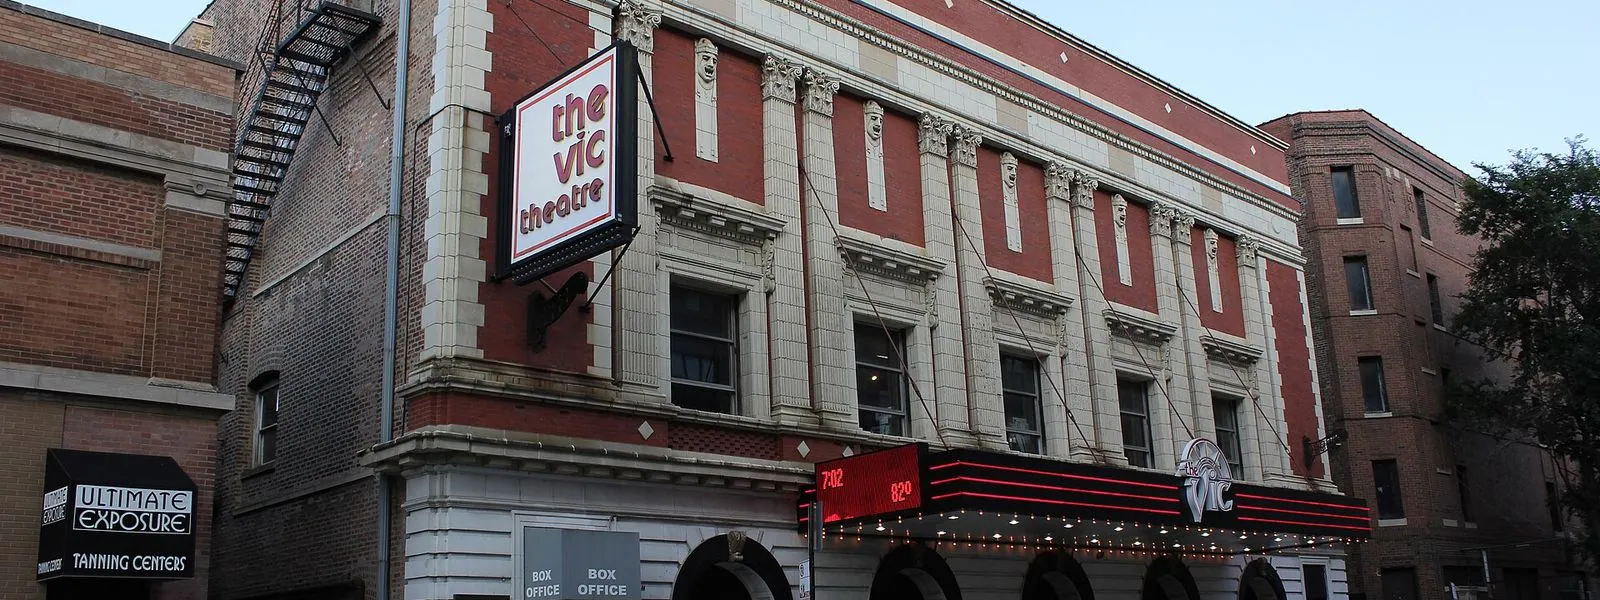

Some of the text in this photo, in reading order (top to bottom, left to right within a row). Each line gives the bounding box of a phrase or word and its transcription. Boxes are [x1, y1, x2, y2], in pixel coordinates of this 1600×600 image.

[552, 83, 609, 142] the
[553, 129, 605, 184] vic
[519, 177, 604, 234] theatre
[1185, 461, 1198, 476] the
[821, 468, 844, 490] 7:02
[82, 487, 187, 511] ULTIMATE
[79, 510, 186, 532] EXPOSURE
[73, 553, 187, 571] TANNING CENTERS
[532, 569, 552, 582] BOX
[588, 568, 616, 580] BOX
[526, 584, 560, 598] OFFICE
[577, 584, 627, 596] OFFICE
